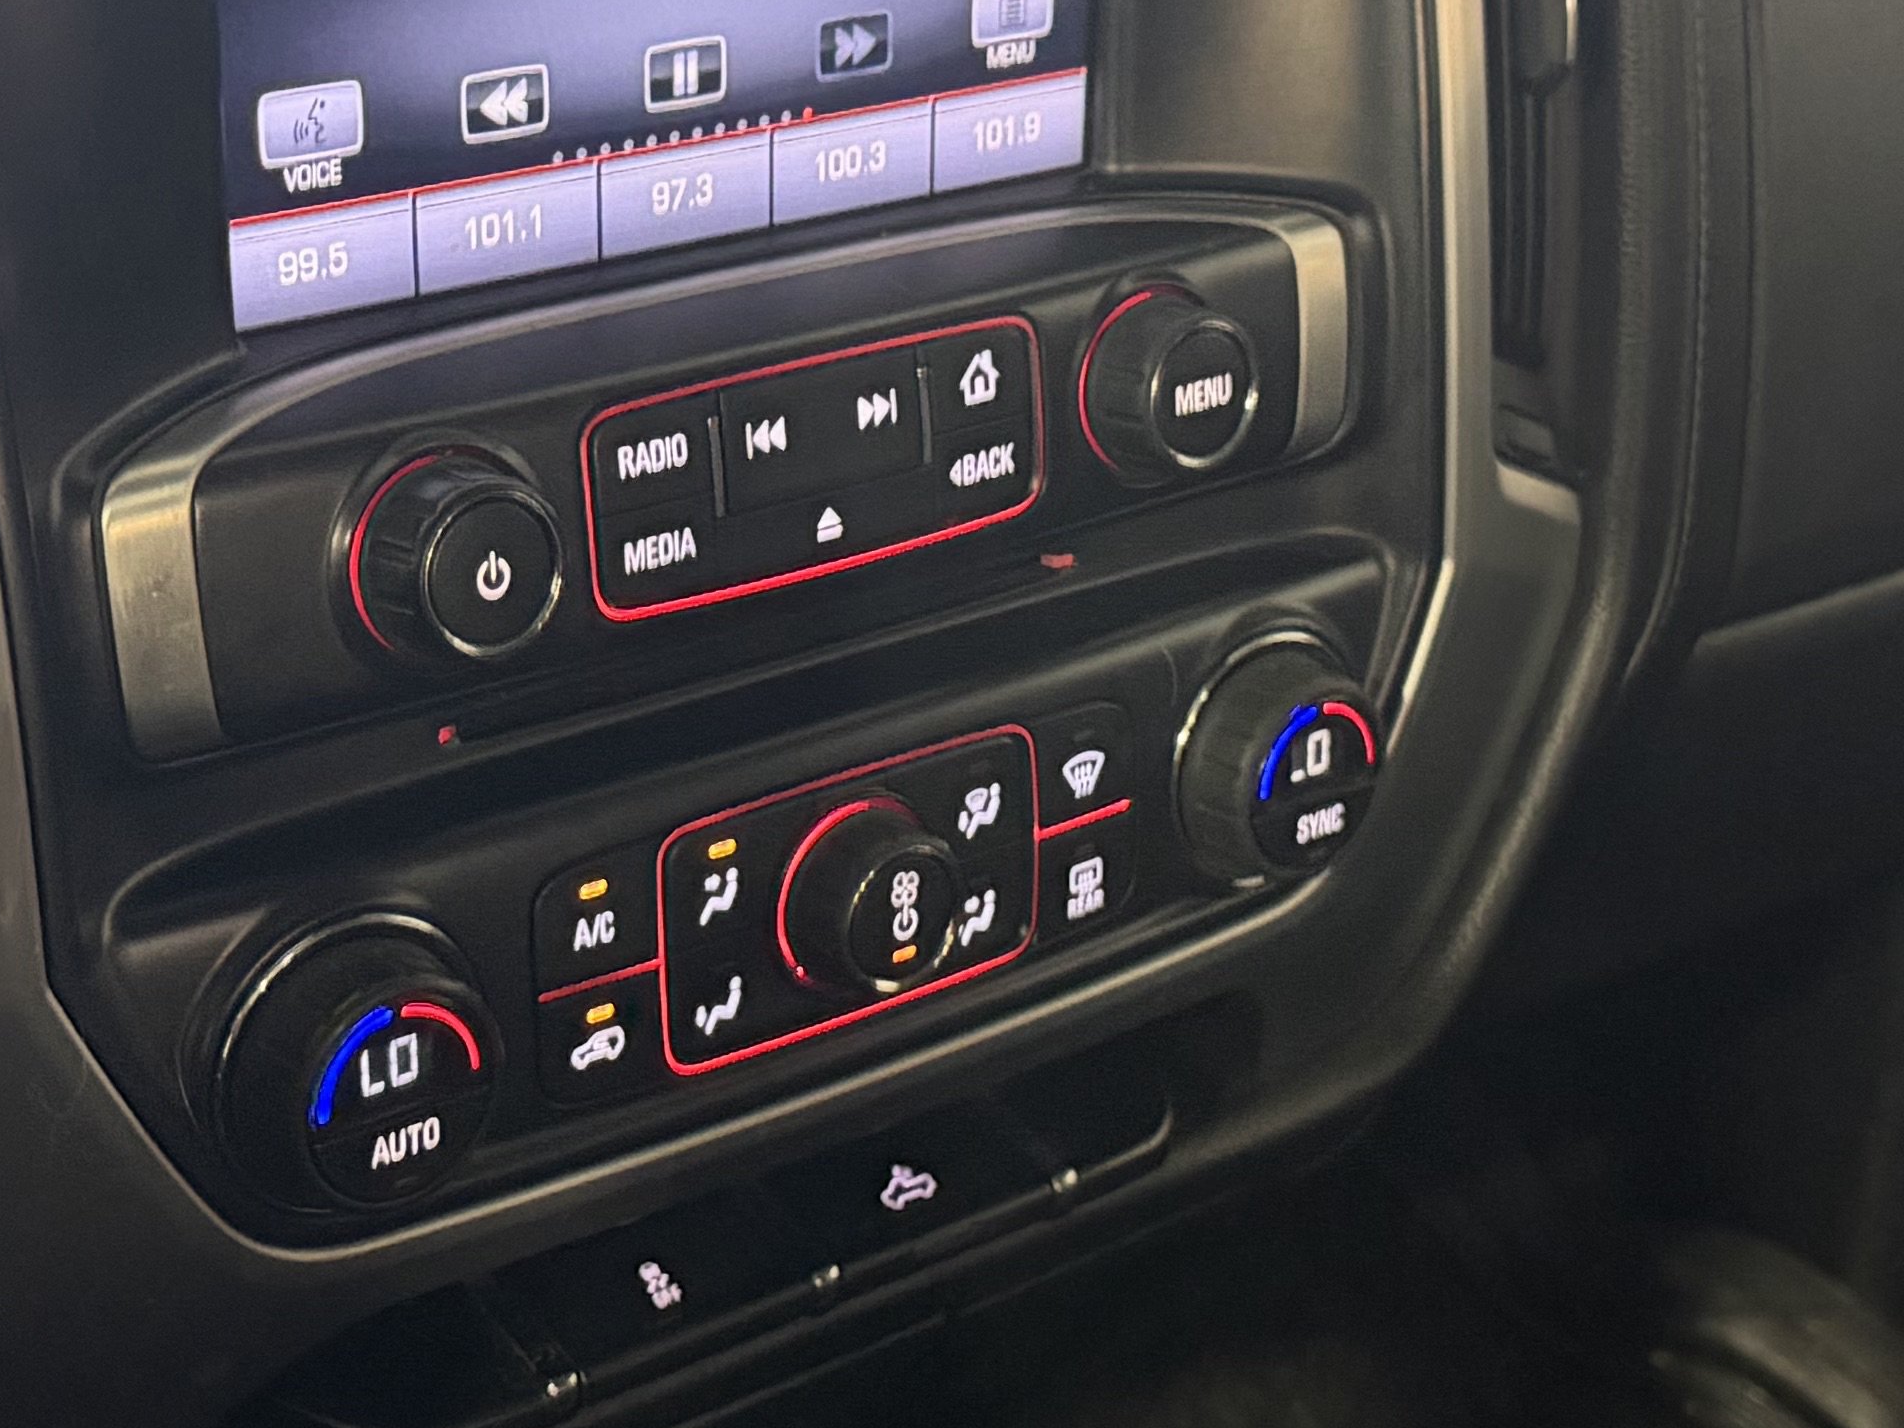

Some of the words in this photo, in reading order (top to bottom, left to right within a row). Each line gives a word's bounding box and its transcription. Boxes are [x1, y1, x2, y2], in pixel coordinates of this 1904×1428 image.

[985, 39, 1037, 69] MENU
[971, 110, 1043, 154] 101.9
[282, 157, 343, 194] VOICE
[813, 138, 887, 184] 100.3
[651, 172, 715, 216] 97.3
[463, 203, 544, 251] 101.1
[277, 241, 350, 286] 99.5
[1174, 373, 1234, 418] MENU
[618, 433, 687, 480] RADIO
[963, 443, 1014, 485] BACK
[624, 527, 696, 574] MEDIA
[1297, 804, 1343, 844] SYNC
[574, 911, 615, 951] A/C
[372, 1117, 439, 1169] AUTO
